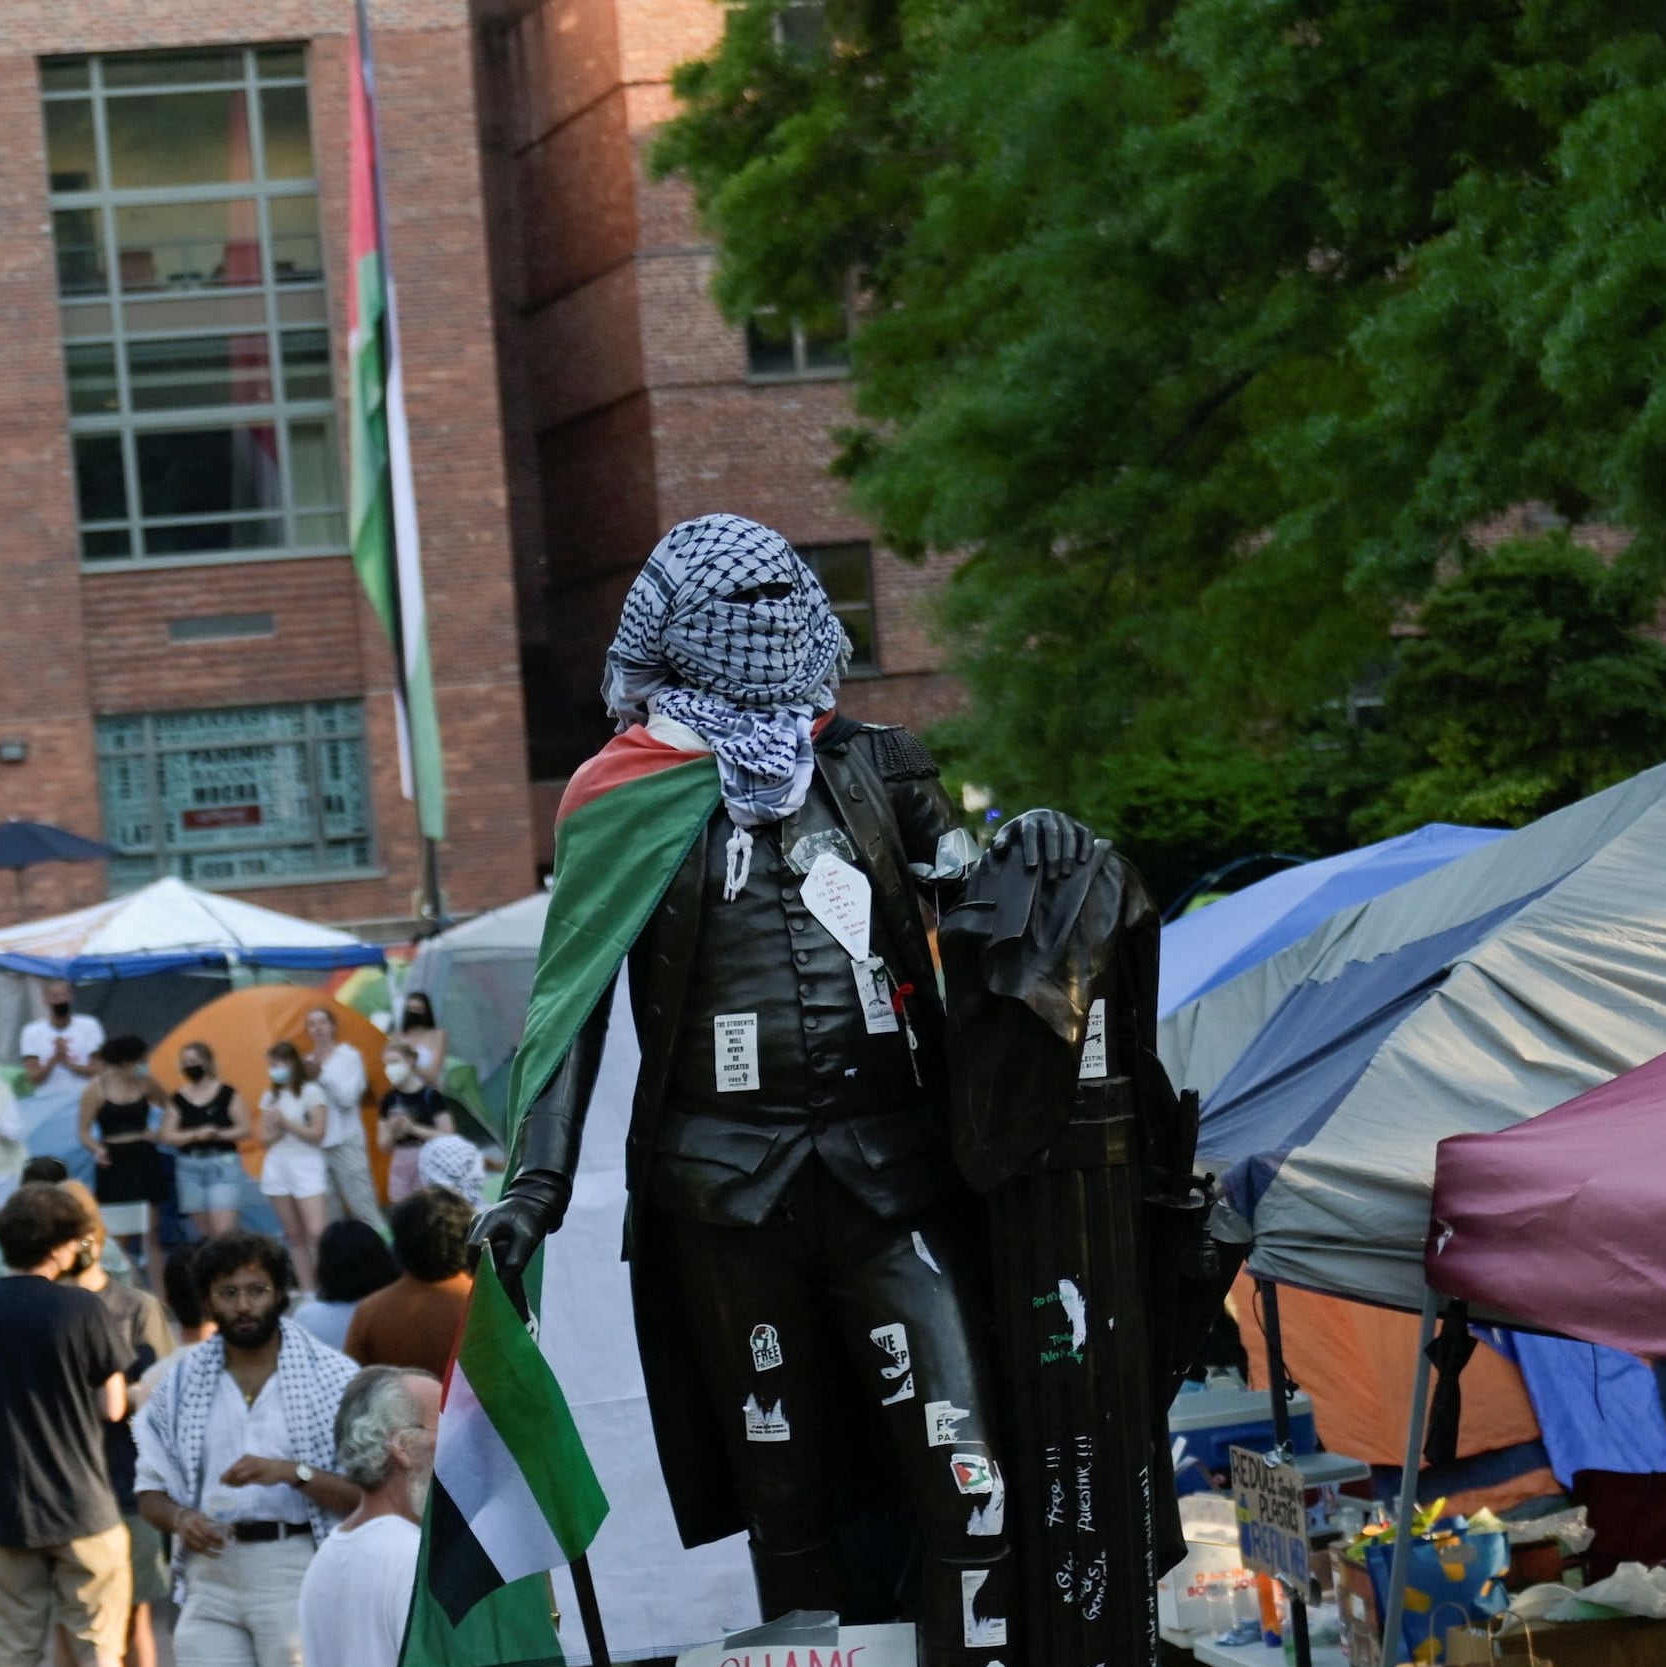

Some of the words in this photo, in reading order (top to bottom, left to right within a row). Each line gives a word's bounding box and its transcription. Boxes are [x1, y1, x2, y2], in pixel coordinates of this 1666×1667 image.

[189, 747, 275, 763] PANINIS
[190, 767, 255, 782] BACON
[194, 783, 257, 803] MOCHA
[754, 1345, 779, 1363] FREE
